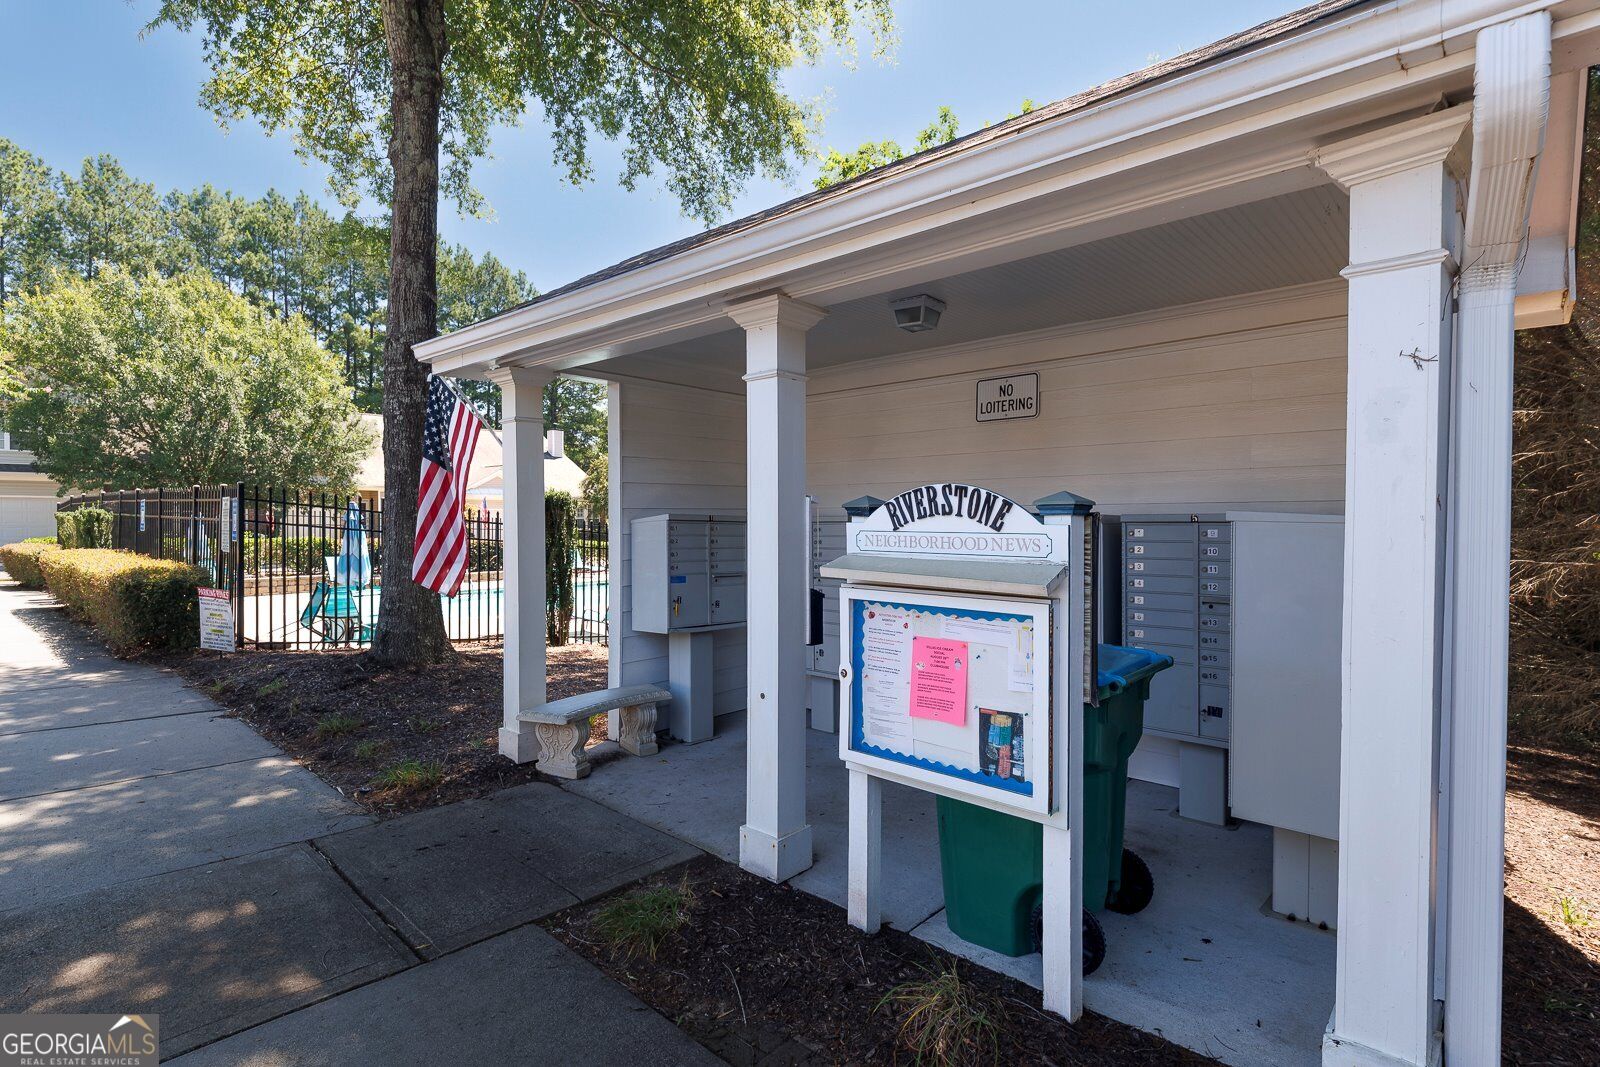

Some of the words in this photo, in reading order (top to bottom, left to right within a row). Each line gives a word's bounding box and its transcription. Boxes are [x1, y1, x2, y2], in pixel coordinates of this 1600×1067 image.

[1000, 384, 1014, 397] NO
[980, 397, 1033, 414] LOITERING
[884, 483, 1014, 532] RIVERSTONE
[864, 534, 988, 552] NEIGHBORHOOD
[990, 537, 1042, 552] NEWS
[198, 588, 216, 598] PARKING
